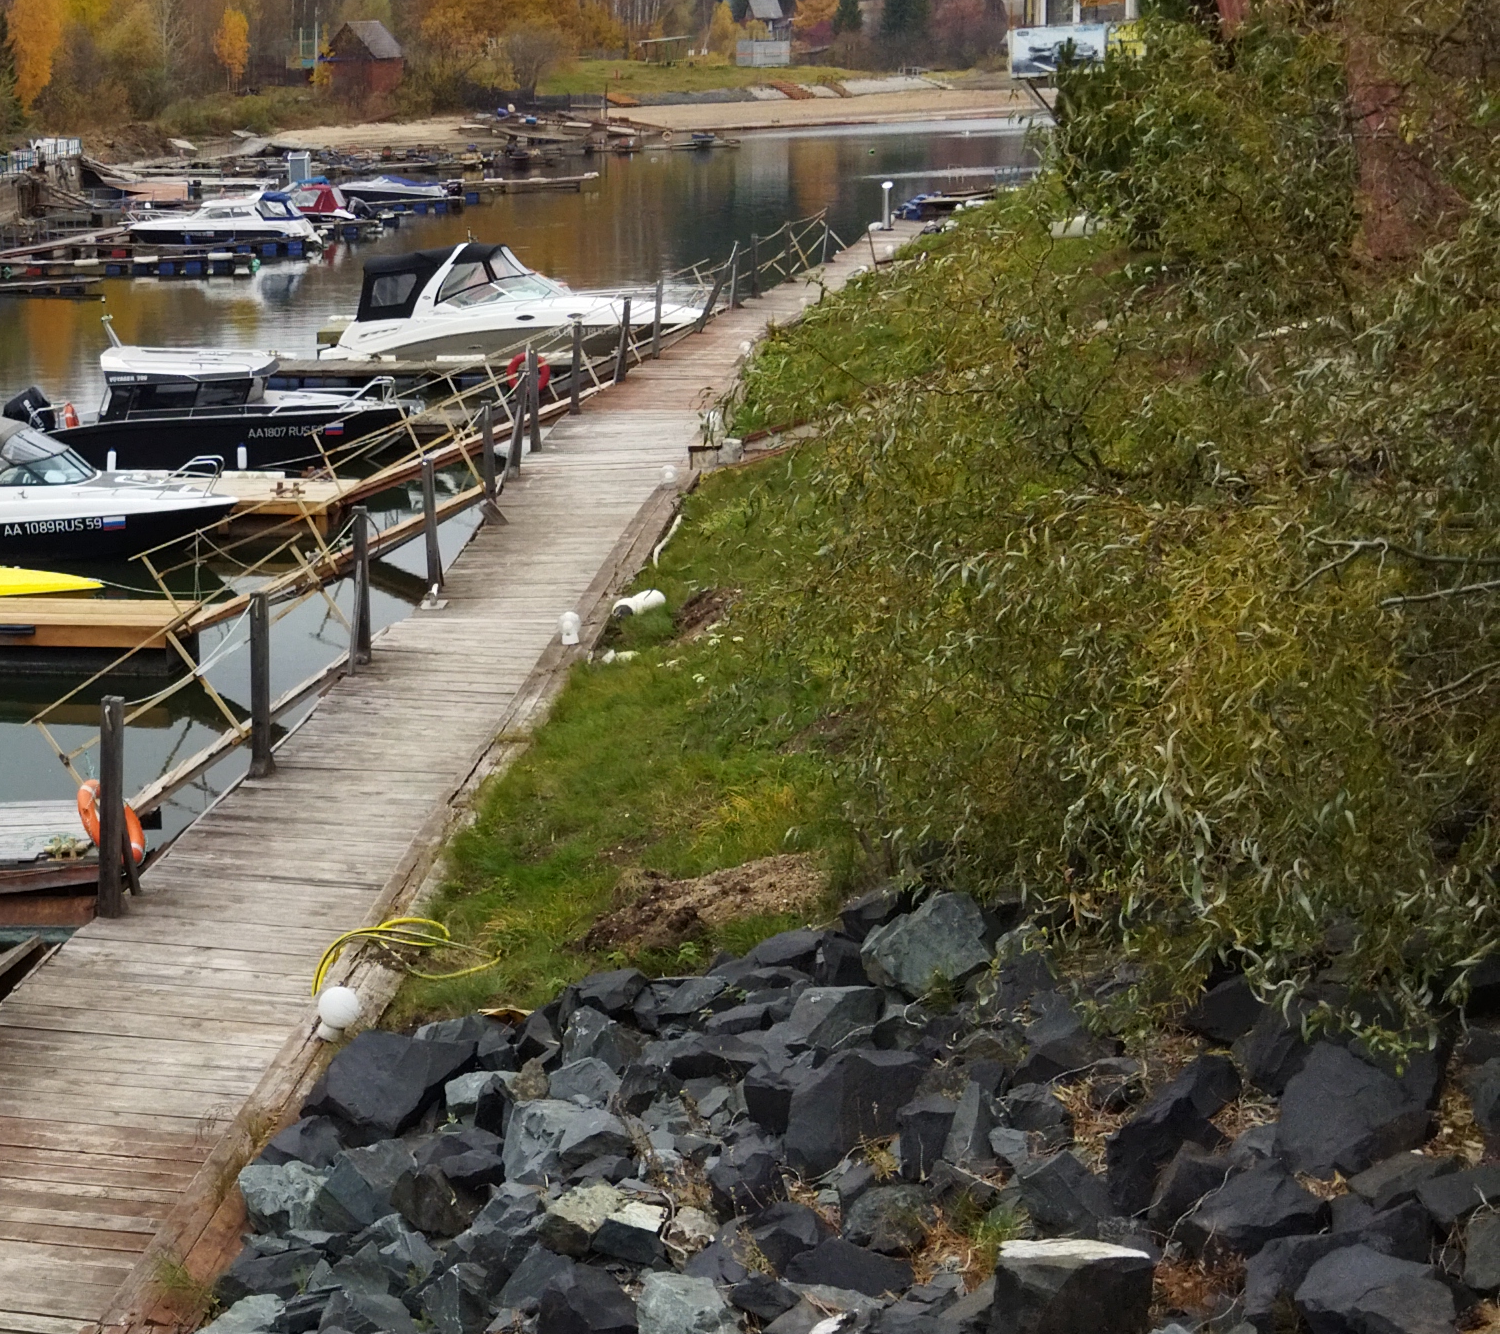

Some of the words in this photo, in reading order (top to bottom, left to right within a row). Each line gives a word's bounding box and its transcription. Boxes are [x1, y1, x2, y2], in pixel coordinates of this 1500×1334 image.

[248, 427, 286, 439] AA1807
[4, 524, 23, 537] AA
[85, 517, 102, 530] 59
